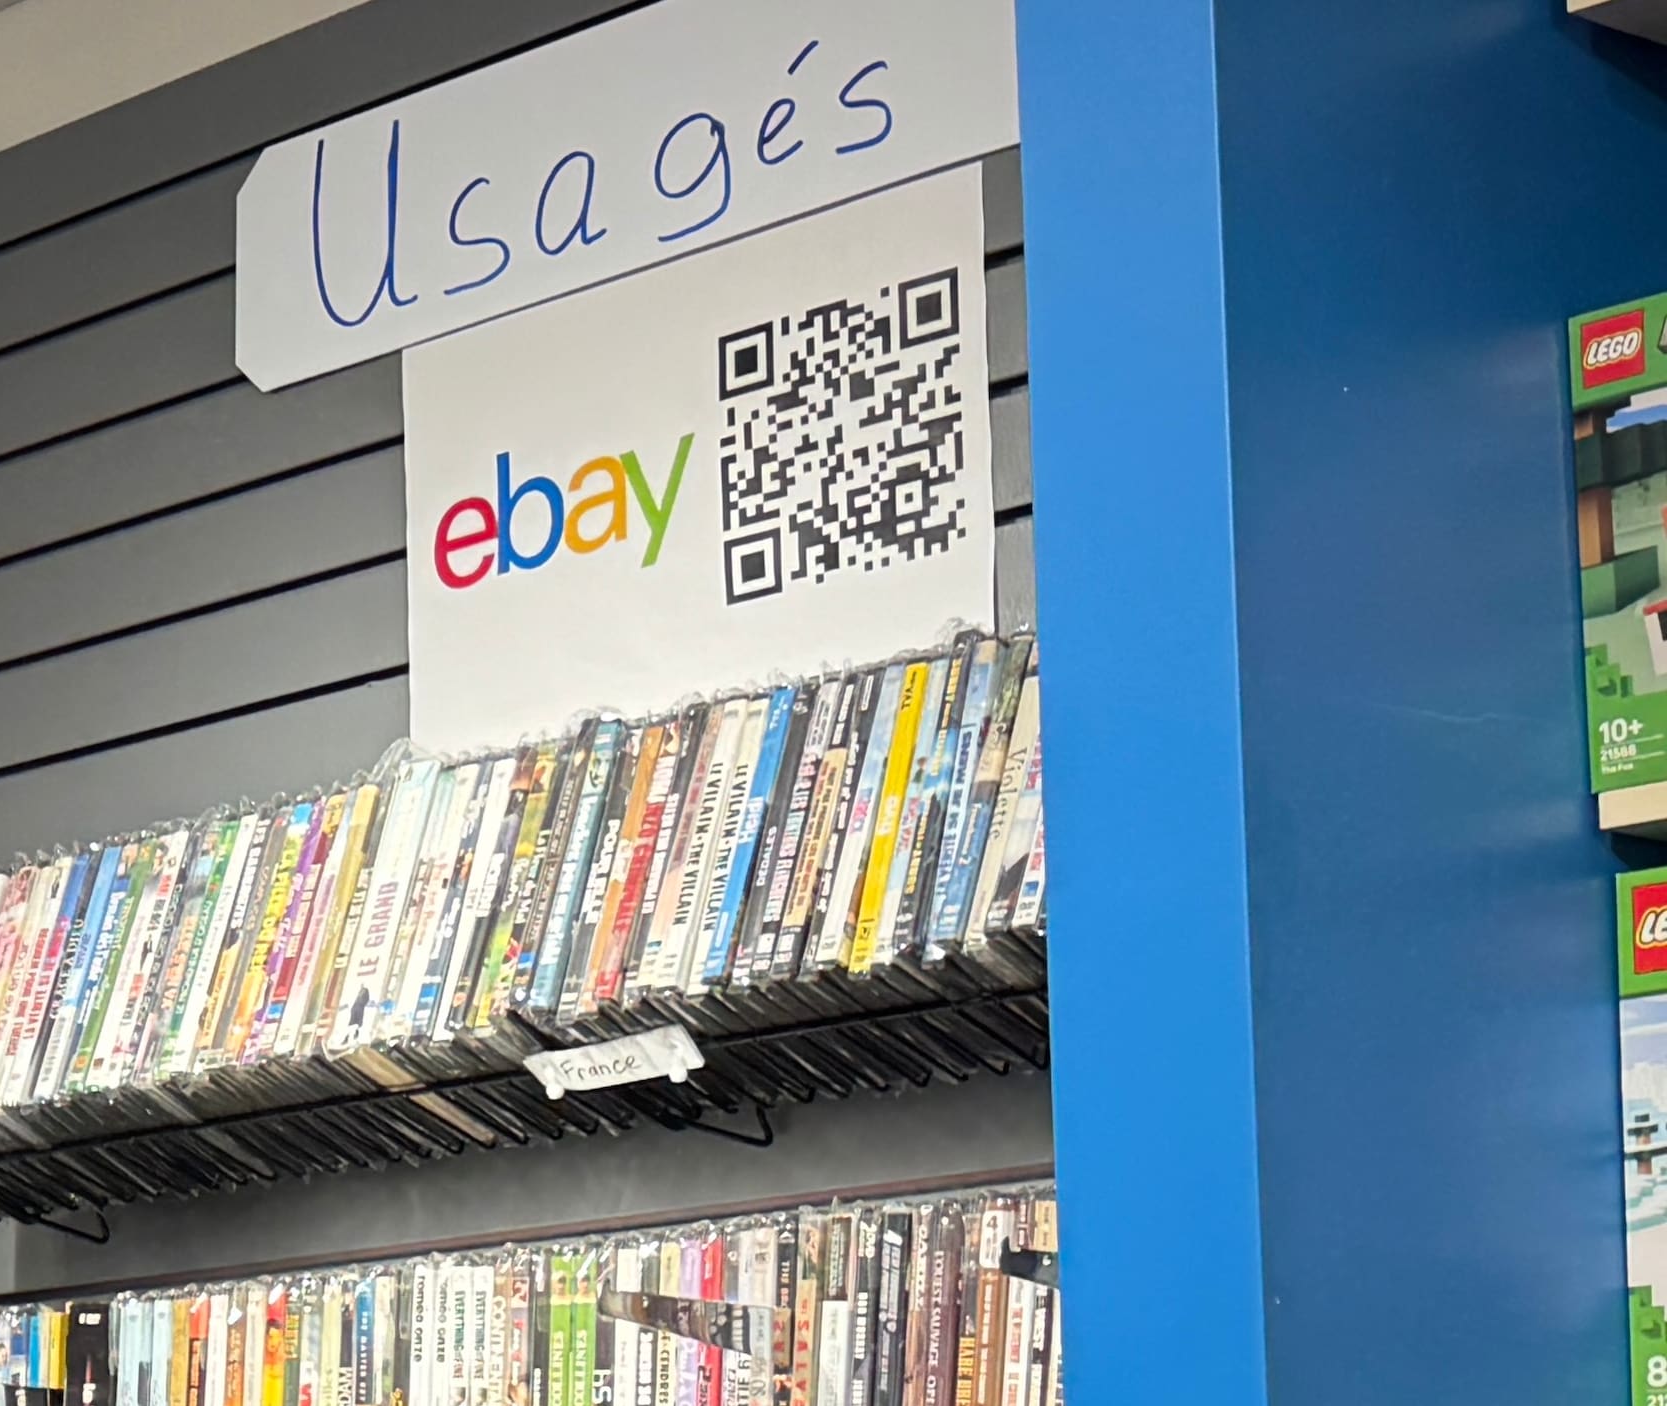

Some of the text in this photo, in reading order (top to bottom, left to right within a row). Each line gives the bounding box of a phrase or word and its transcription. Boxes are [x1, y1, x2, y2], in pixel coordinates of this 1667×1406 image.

[312, 39, 893, 328] Usagés
[1585, 330, 1640, 367] LEGO
[433, 432, 695, 590] ebay
[1599, 718, 1643, 744] 10+
[986, 746, 1028, 842] Violette
[672, 761, 724, 927] LE VILAIN THE VILLAIN
[702, 763, 749, 931] LE VILAIN THE VILLAIN
[357, 881, 398, 978] LE GRAND
[559, 1055, 643, 1082] France
[931, 1250, 945, 1304] L'OUEST
[411, 1274, 429, 1363] roméo onze
[435, 1326, 447, 1363] onze
[452, 1289, 465, 1352] EVERYTHING
[473, 1289, 486, 1352] EVERYTHING
[928, 1306, 941, 1367] SAUVAGE
